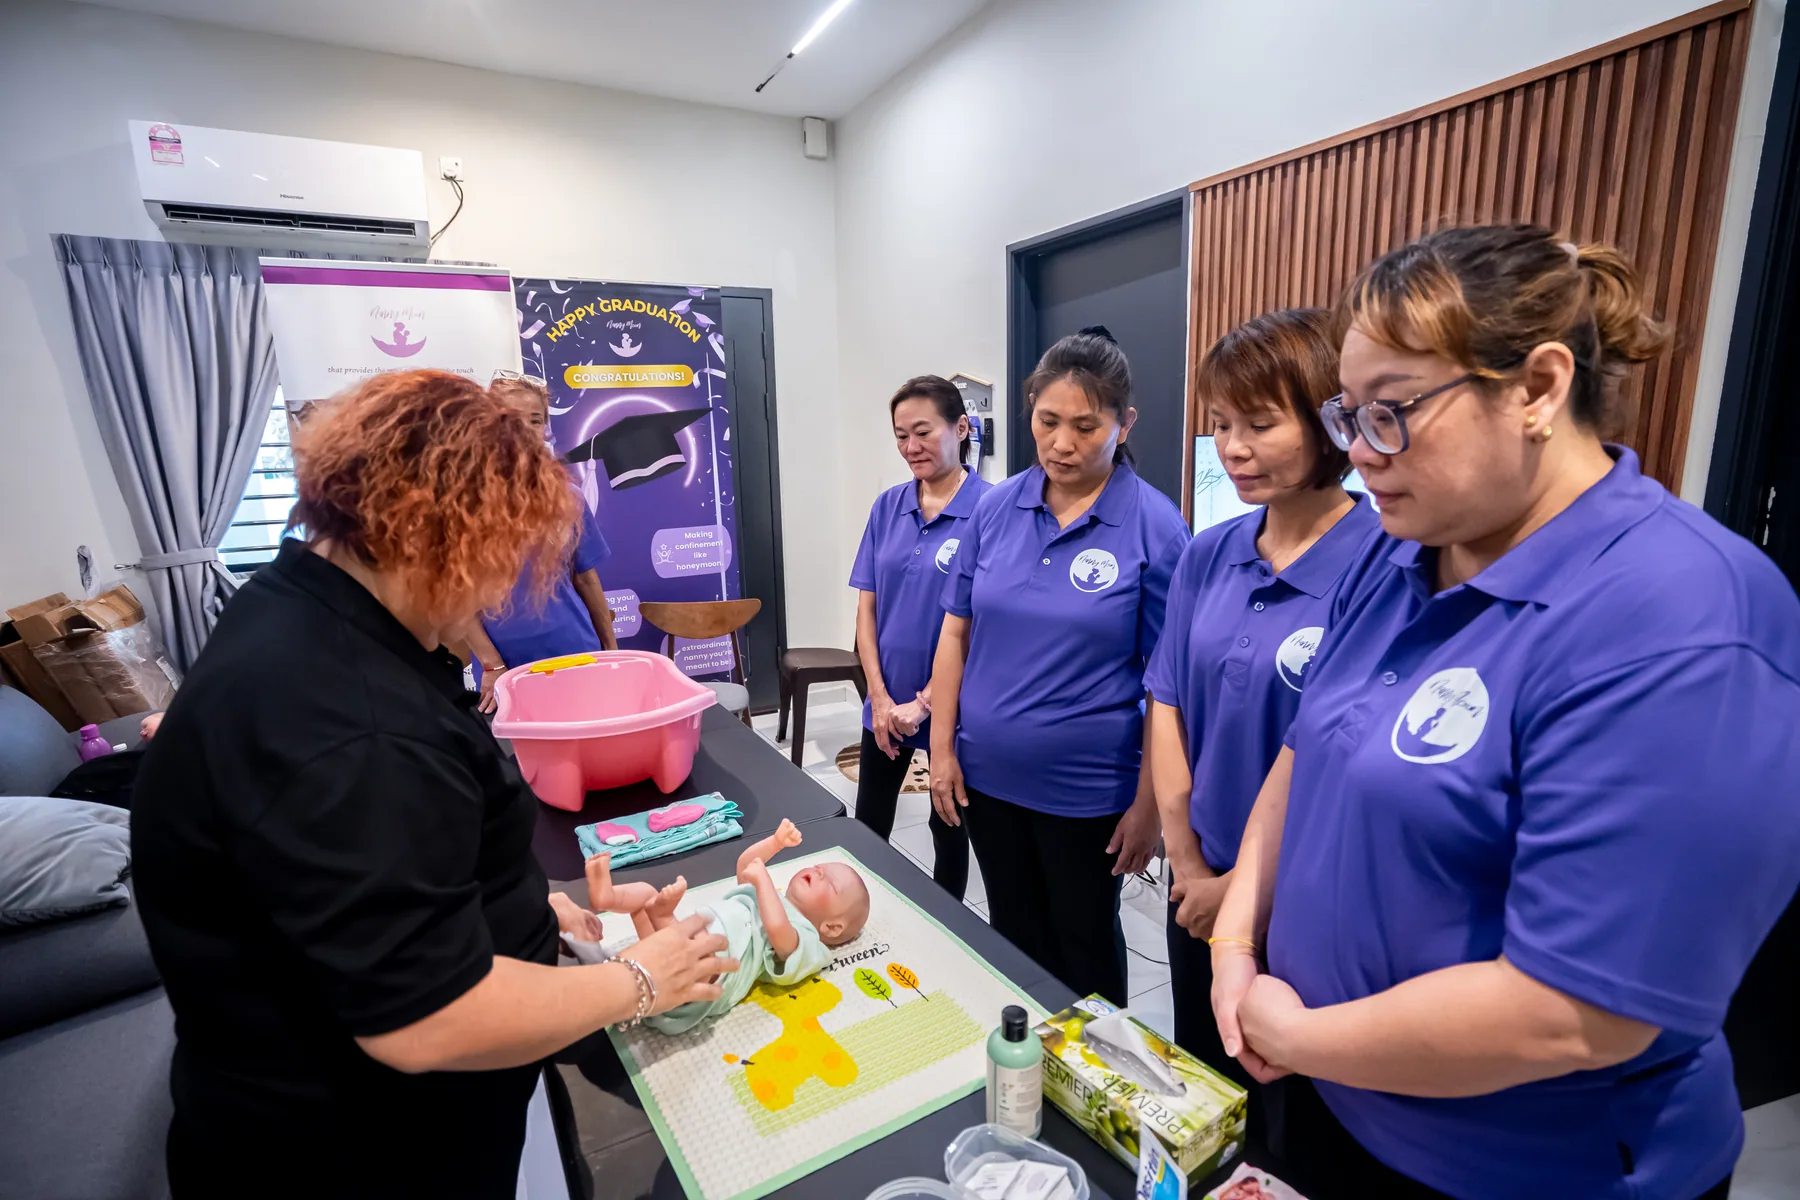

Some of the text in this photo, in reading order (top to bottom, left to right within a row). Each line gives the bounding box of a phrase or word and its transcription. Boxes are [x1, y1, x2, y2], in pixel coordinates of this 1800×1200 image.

[546, 298, 701, 344] HAPPY GRADUATION
[327, 366, 343, 374] that
[344, 366, 374, 375] provides
[572, 371, 686, 383] CONGRATULATIONS!
[684, 530, 713, 539] Making
[674, 540, 724, 550] confinement
[693, 551, 708, 559] like
[676, 560, 724, 571] honeymoon.
[616, 594, 635, 604] your
[681, 640, 733, 652] extraordinary
[683, 653, 709, 662] nanny
[685, 661, 711, 671] meant
[720, 658, 732, 666] be!
[1042, 1053, 1094, 1108] REMIER
[1103, 1074, 1187, 1135] PREMIER
